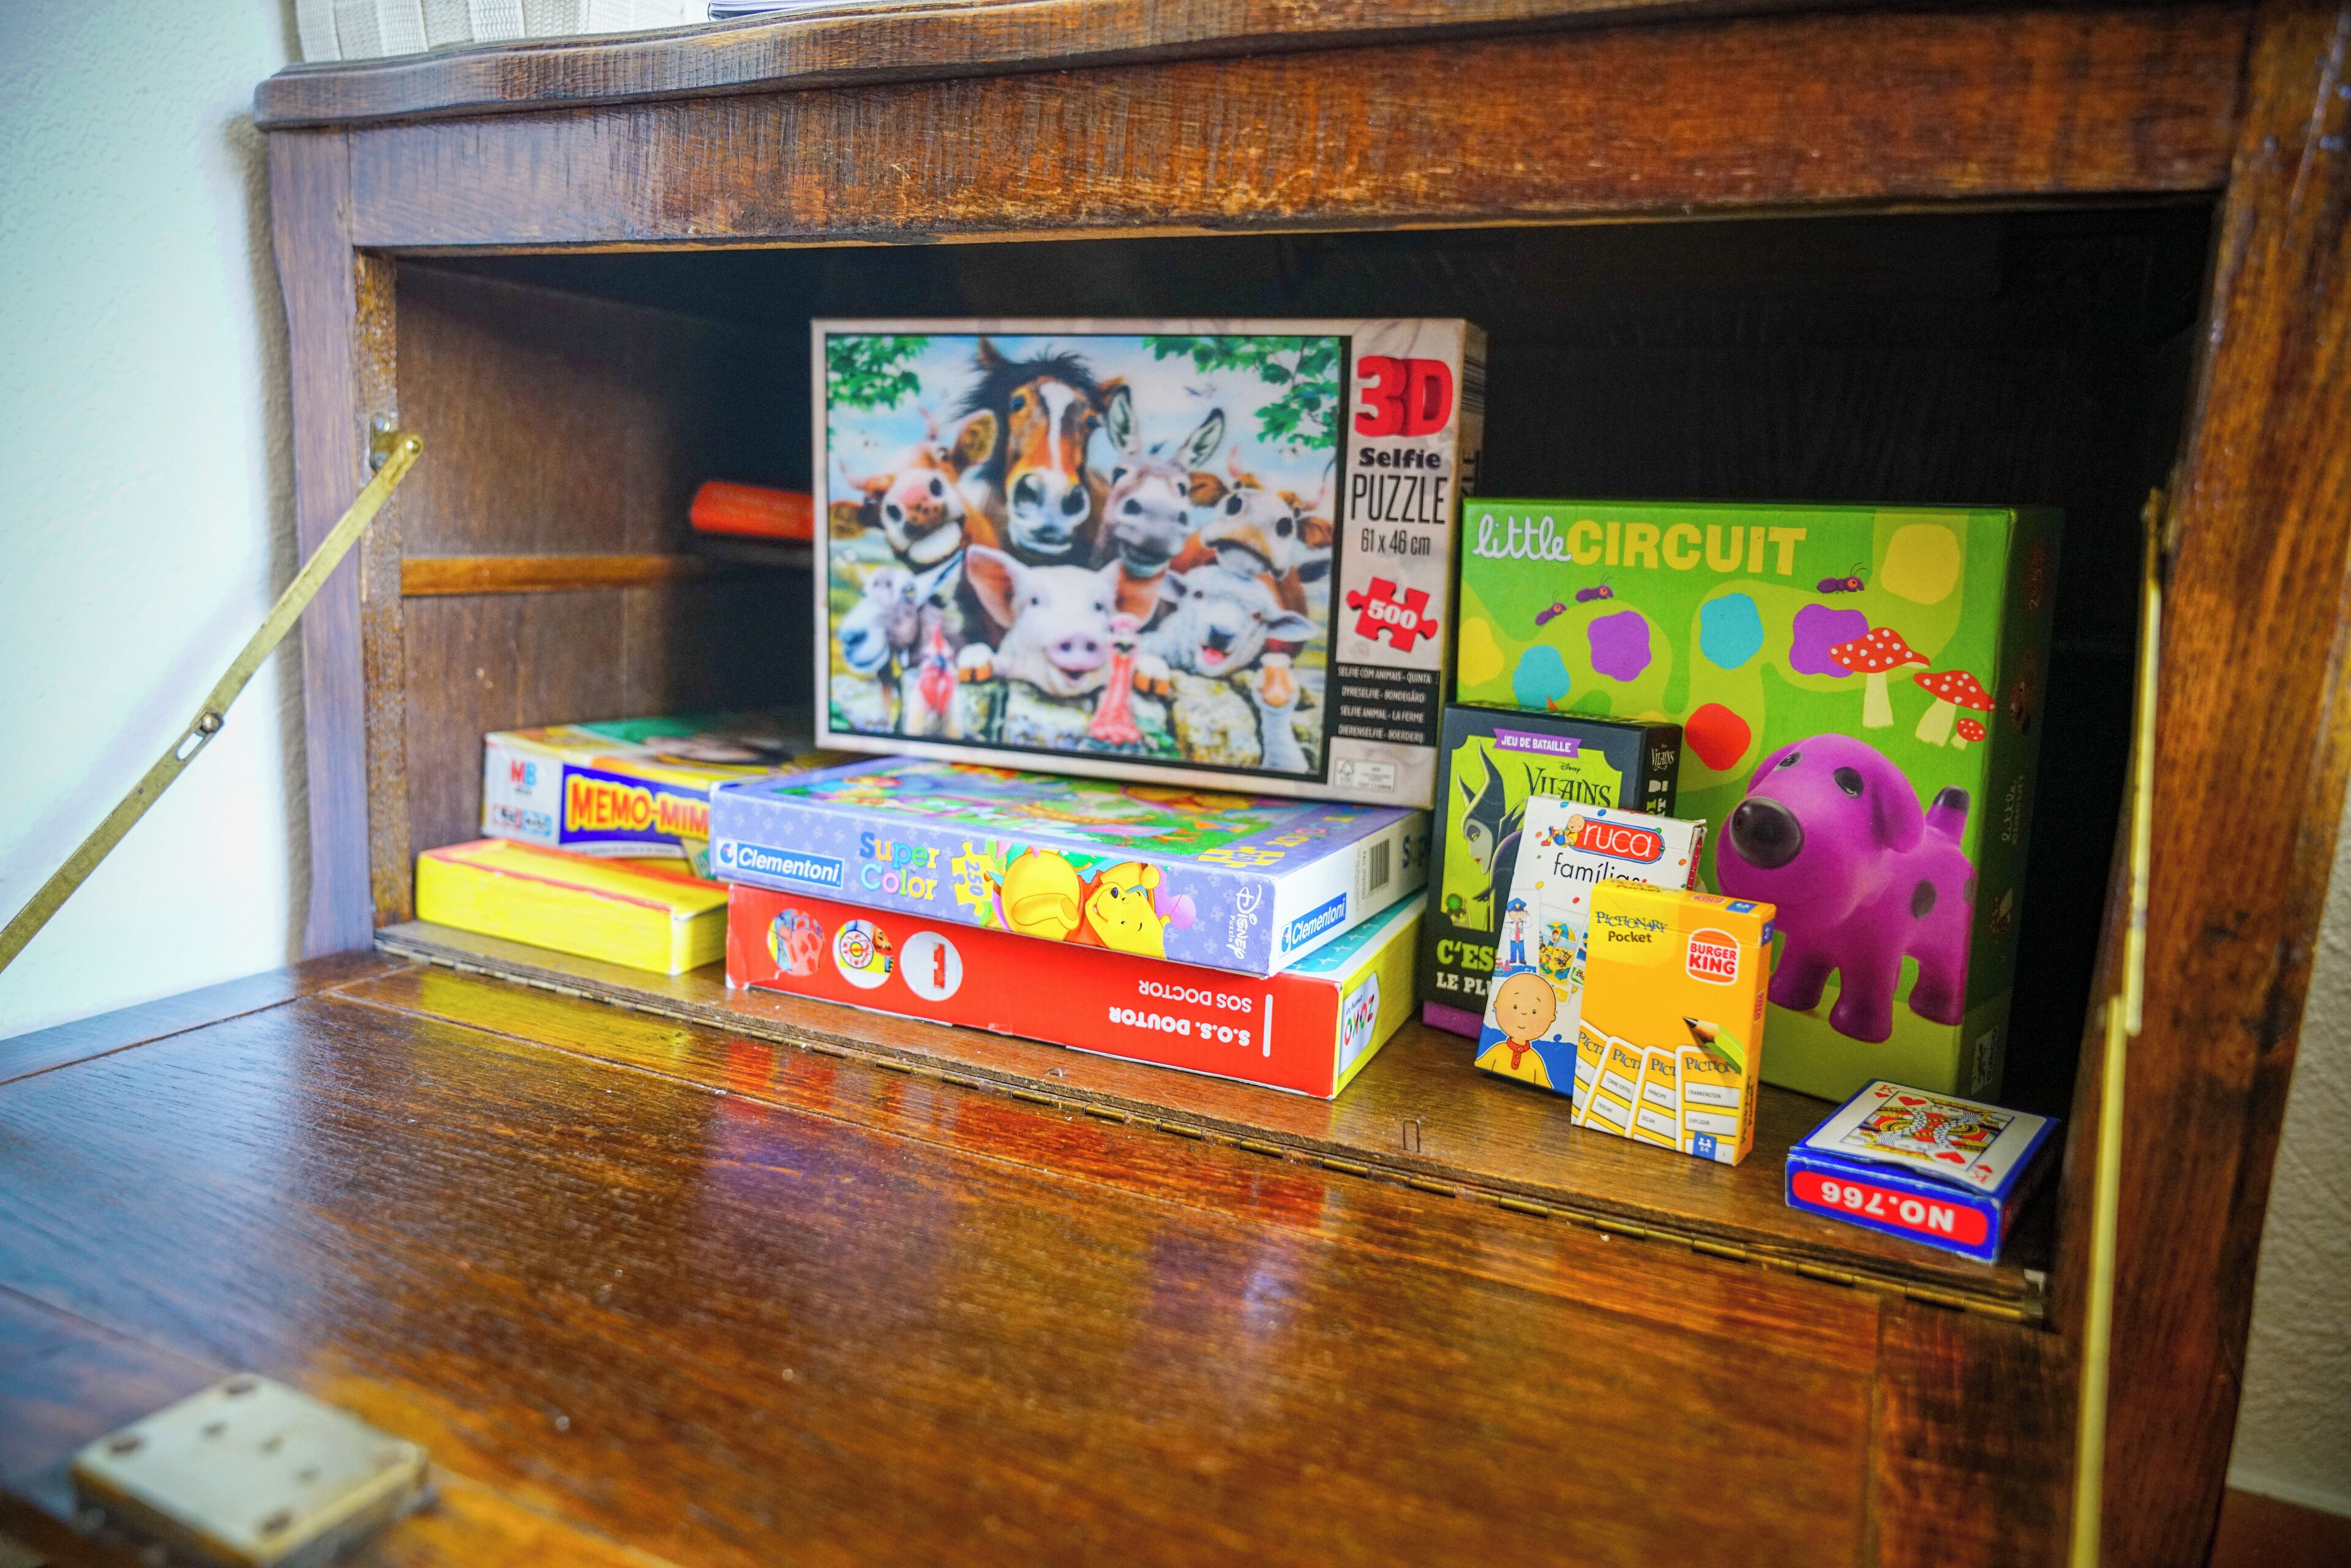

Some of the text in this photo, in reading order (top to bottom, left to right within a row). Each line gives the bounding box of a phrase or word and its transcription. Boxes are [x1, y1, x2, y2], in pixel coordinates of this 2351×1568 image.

[1354, 354, 1453, 438] 3D
[1359, 447, 1441, 470] Selfie
[1351, 474, 1447, 524] PUZZLE
[1361, 528, 1430, 556] 61 x 46 cm
[1474, 514, 1807, 576] little CIRCUIT
[1367, 599, 1417, 629] 500
[1338, 666, 1359, 678] SELFIE
[1360, 667, 1373, 680] COM
[1374, 668, 1401, 681] ANIMAIS
[1407, 672, 1431, 684] QUINTA
[1340, 705, 1362, 718] SELFIE
[1362, 707, 1387, 720] ANIMAL
[1392, 711, 1401, 721] LA
[1402, 711, 1425, 723] FERME
[1501, 735, 1572, 752] JEU DE BATAILLE
[511, 759, 536, 787] MB
[860, 831, 940, 869] Super
[1583, 824, 1652, 857] ruca
[738, 847, 840, 882] Clementoni
[861, 863, 937, 901] Color
[964, 860, 984, 896] 250
[1292, 898, 1346, 945] Clementoni
[1596, 911, 1667, 932] PICTIONARY
[1608, 931, 1652, 943] Pocket
[1436, 939, 1498, 972] C'ES
[1690, 943, 1736, 960] BURGER
[1689, 954, 1735, 975] KING
[1436, 972, 1459, 991] LE
[1138, 980, 1252, 1013] SOS DOCTOR
[1109, 1006, 1251, 1046] S.O.S. DOUTOR
[1606, 1077, 1618, 1087] TORRE
[1688, 1089, 1721, 1099] FRANKENSTEIN
[1878, 1084, 1898, 1094] K
[1597, 1101, 1612, 1112] TROCAR
[1641, 1115, 1655, 1124] SECAR
[1688, 1117, 1710, 1126] EXPLODIR
[1970, 1171, 1989, 1183] K
[1821, 1182, 1954, 1232] NO.766
